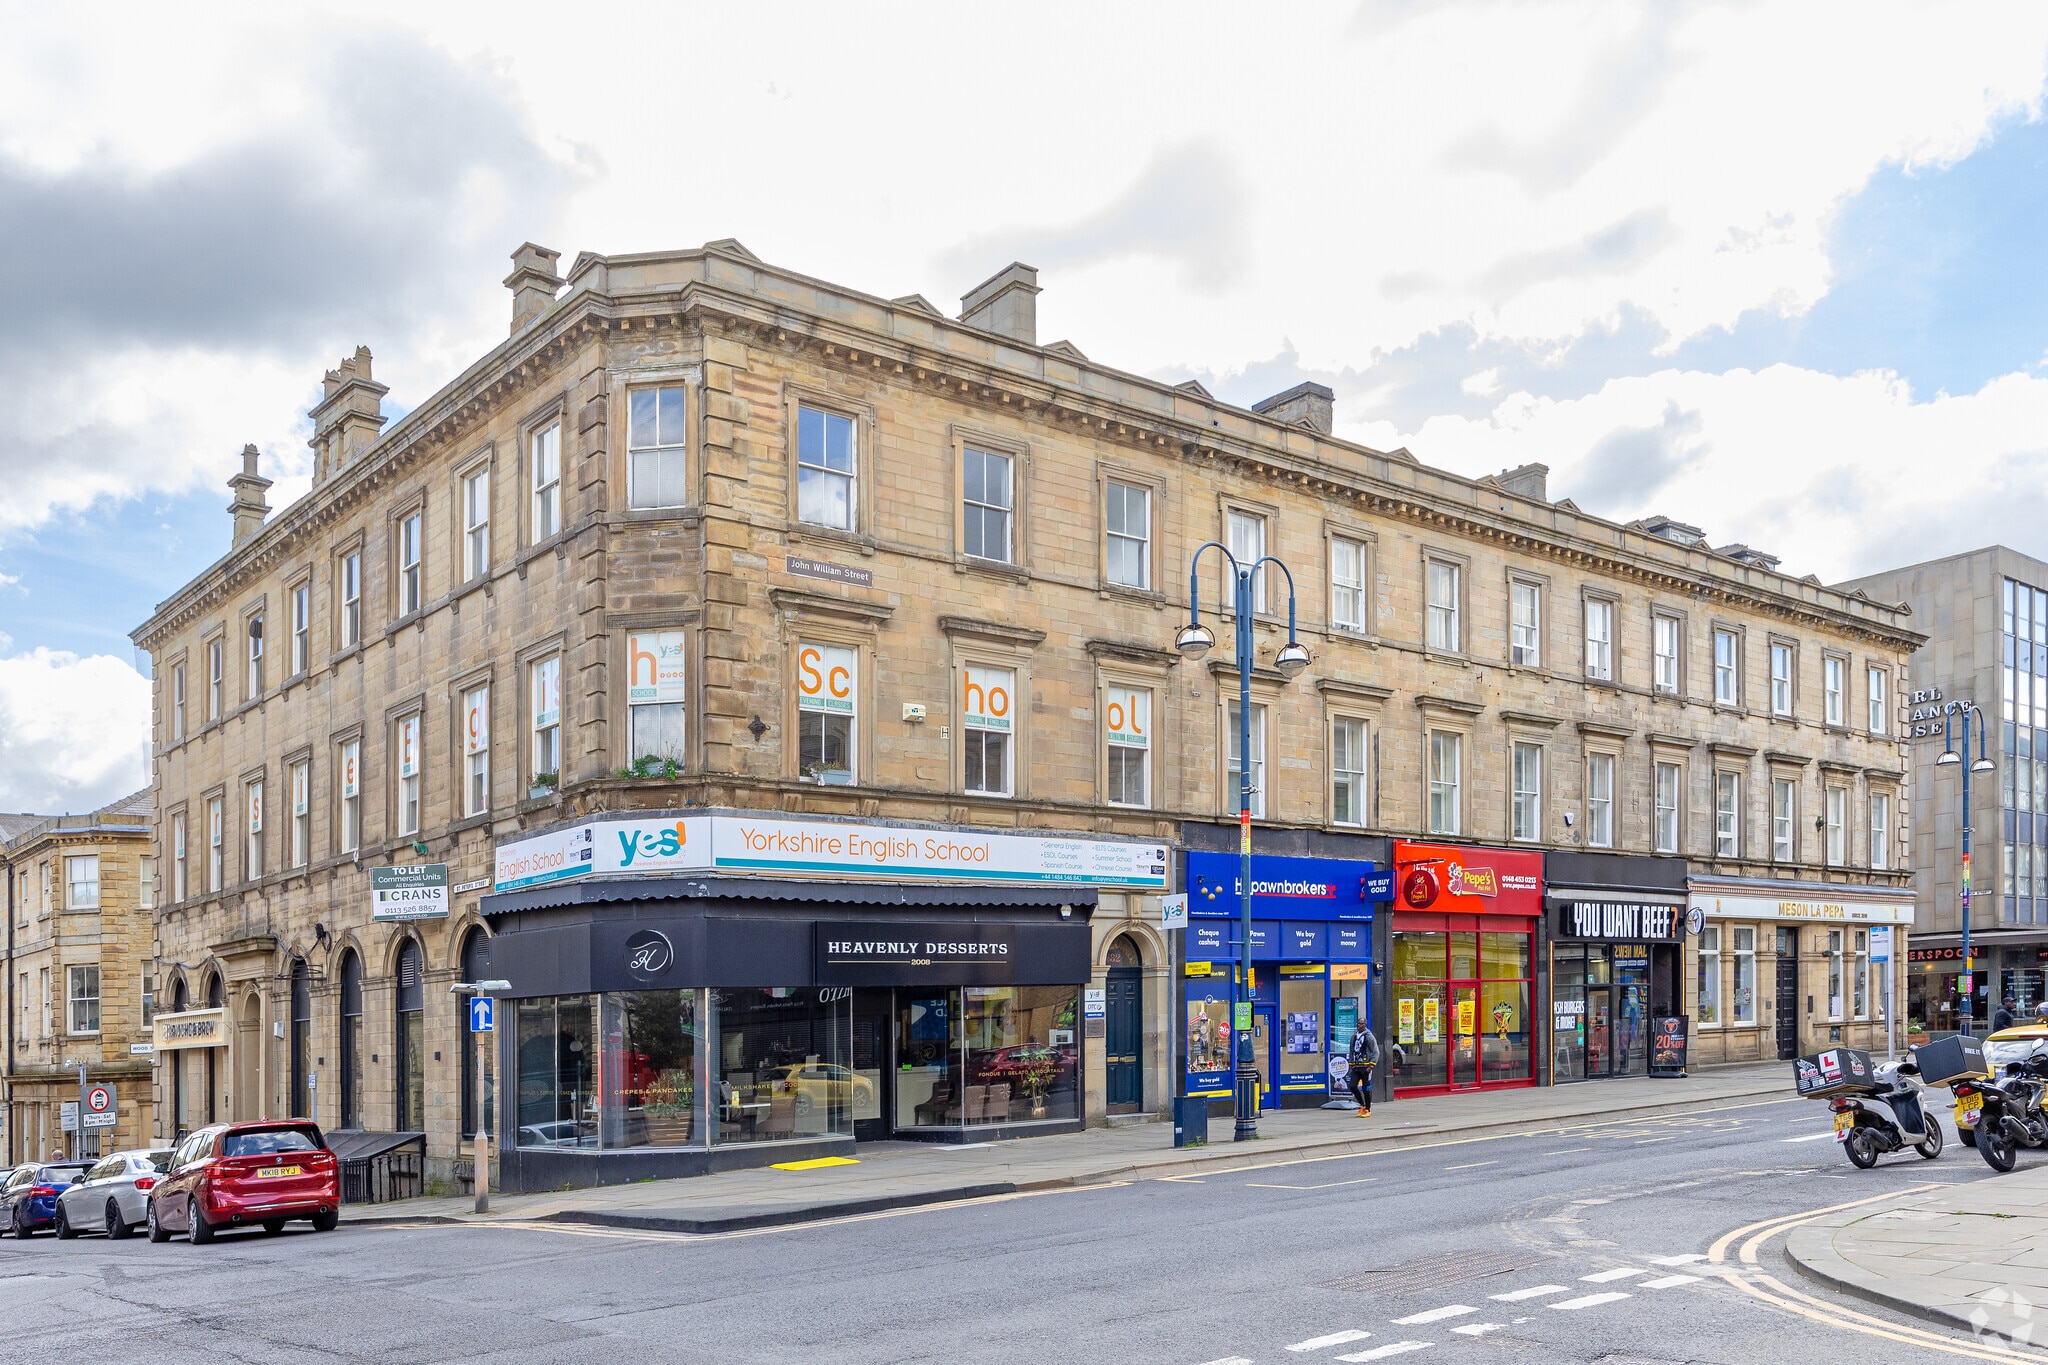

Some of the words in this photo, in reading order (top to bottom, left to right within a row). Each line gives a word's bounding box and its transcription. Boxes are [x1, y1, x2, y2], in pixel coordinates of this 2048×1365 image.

[791, 560, 810, 570] John
[813, 563, 842, 576] William
[845, 569, 869, 581] Street
[1913, 687, 1942, 704] RL
[1912, 700, 1972, 722] ANCE
[740, 827, 842, 855] Yorkshire
[849, 834, 918, 863] English
[925, 838, 989, 863] School
[1044, 841, 1065, 849] General
[1066, 843, 1082, 851] English
[499, 856, 530, 880] English
[532, 847, 565, 871] School
[1115, 855, 1132, 863] School
[392, 867, 407, 876] TO
[409, 866, 427, 874] LET
[378, 875, 421, 884] Commercial
[1378, 878, 1390, 886] BUY
[1464, 872, 1491, 888] Pepe's
[1250, 880, 1327, 896] pawnbrokers
[1370, 886, 1387, 894] GOLD
[391, 889, 442, 902] CRANS
[1778, 902, 1809, 917] MESON
[1810, 904, 1822, 918] LA
[1824, 904, 1845, 919] PEPA
[1574, 902, 1601, 937] YOU
[1602, 904, 1640, 938] WANT
[1642, 906, 1679, 939] BEEF?
[1198, 929, 1219, 937] Cheque
[1306, 930, 1316, 939] buy
[828, 942, 919, 954] HEAVENLY
[926, 942, 1008, 955] DESSERTS
[1198, 938, 1220, 948] cashing
[1300, 940, 1312, 948] gold
[1340, 940, 1357, 948] money
[1908, 947, 1979, 961] ERSPOON
[911, 958, 931, 966] 2008
[1564, 1000, 1585, 1014] BURGERS
[1656, 1034, 1671, 1049] 20
[1824, 1056, 1835, 1068] L
[652, 1086, 693, 1095] PANCAKES
[1961, 1094, 1980, 1106] LD15
[1962, 1102, 1979, 1112] LCP
[262, 1168, 279, 1177] MK18
[280, 1167, 296, 1176] RYJ
